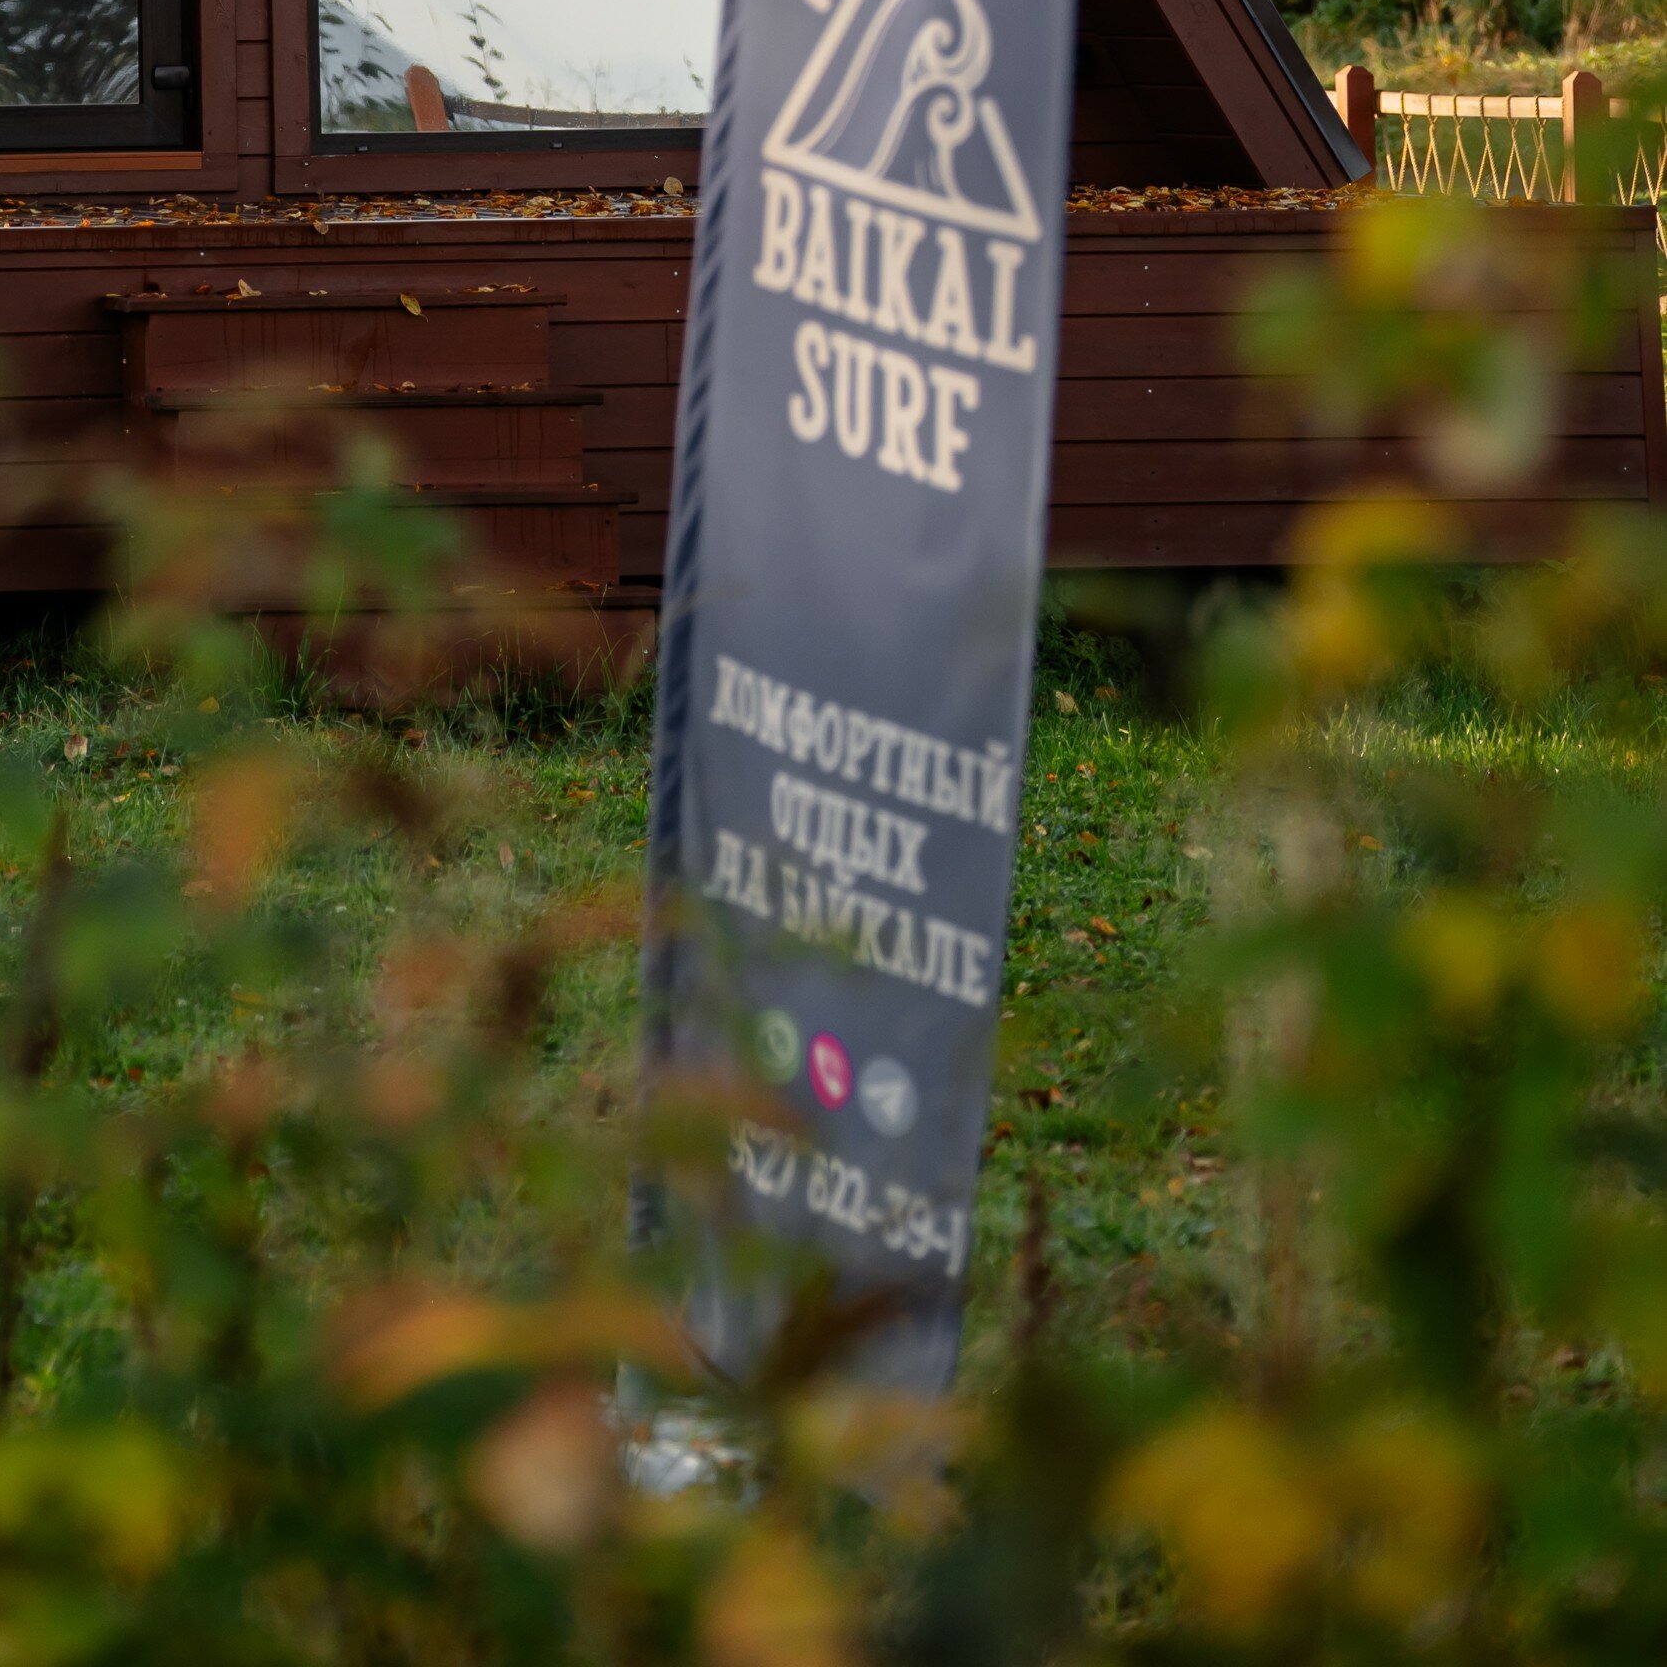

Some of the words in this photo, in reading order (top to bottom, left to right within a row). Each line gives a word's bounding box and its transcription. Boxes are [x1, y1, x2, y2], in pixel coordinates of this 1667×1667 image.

[753, 168, 1037, 373] BAIKAL
[787, 320, 982, 494] SURF
[709, 655, 1013, 834] КОМФОРТНЫЙ
[771, 771, 929, 895] ОТДЫХ
[703, 828, 771, 918] НА
[781, 863, 990, 1008] БАЙКАЛЕ
